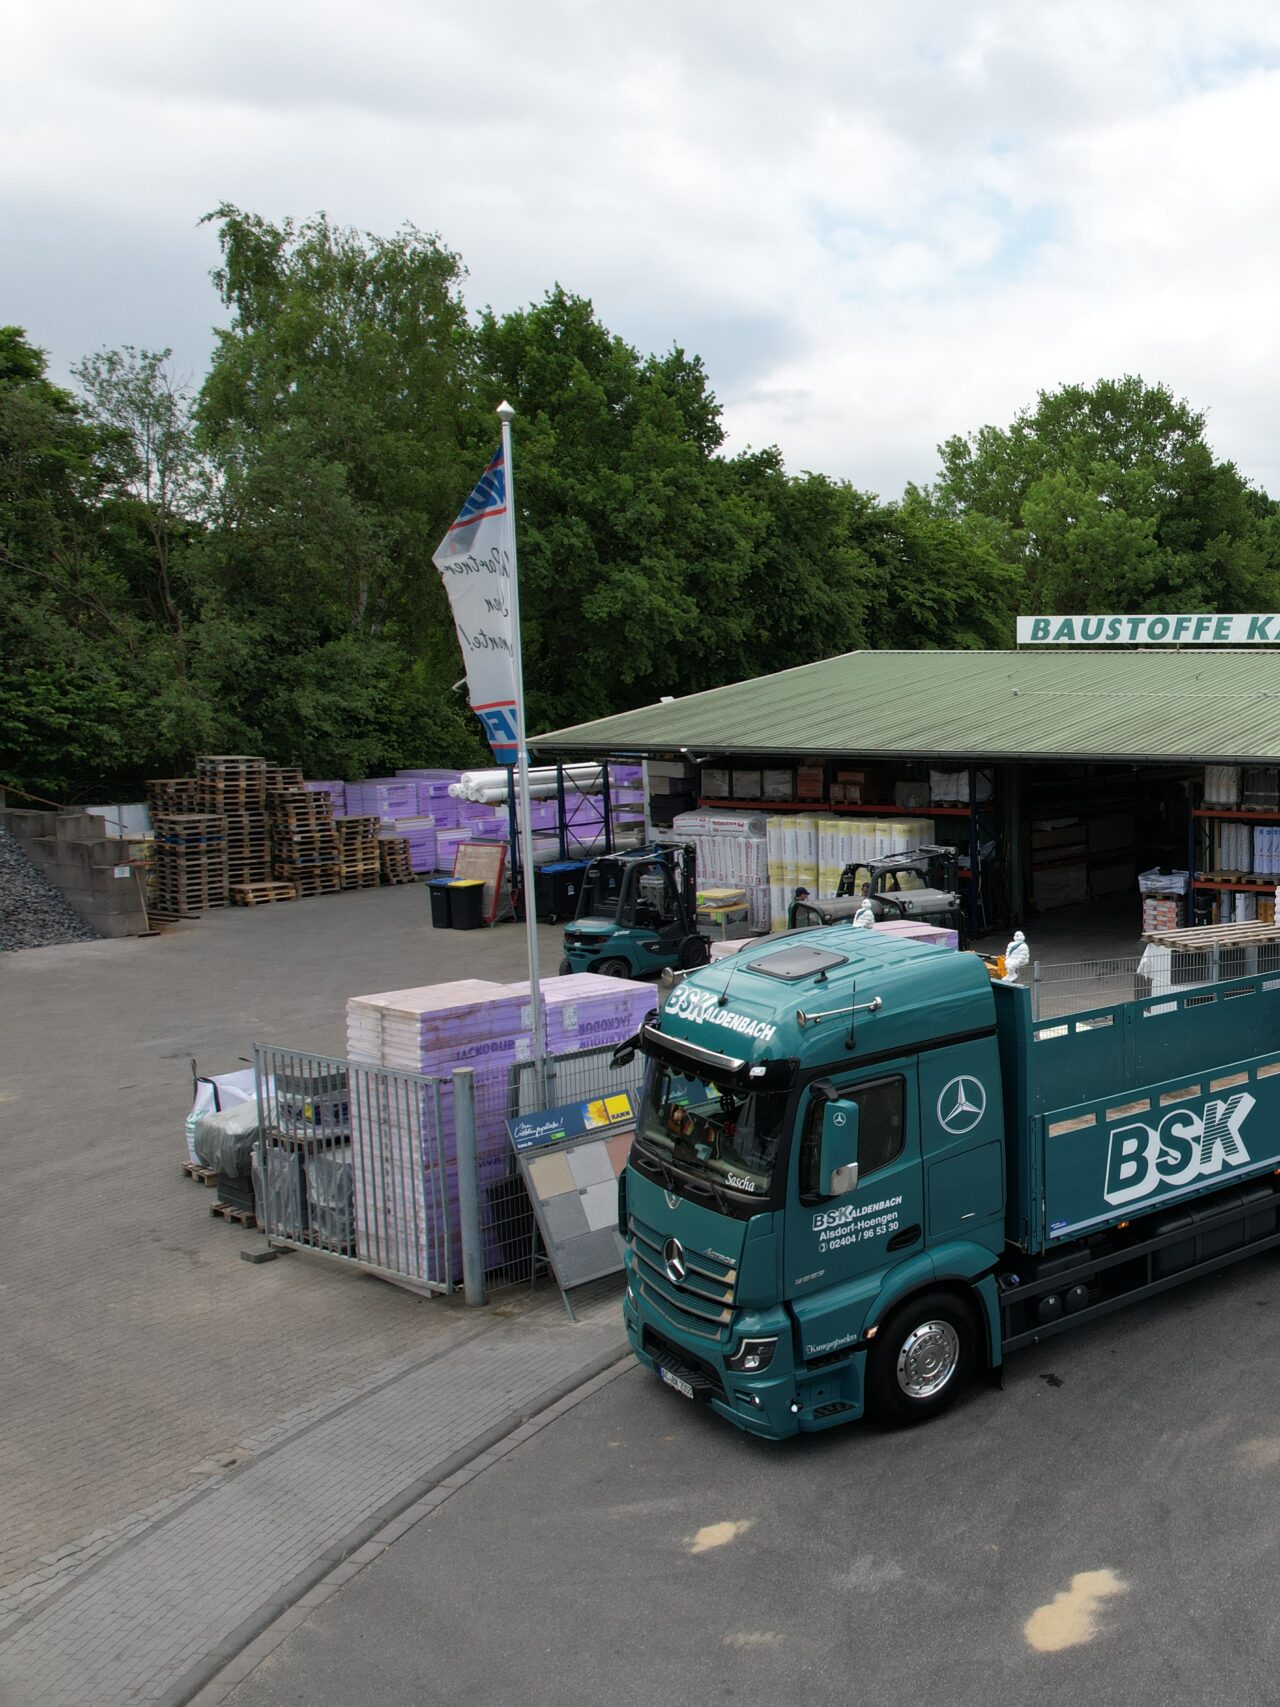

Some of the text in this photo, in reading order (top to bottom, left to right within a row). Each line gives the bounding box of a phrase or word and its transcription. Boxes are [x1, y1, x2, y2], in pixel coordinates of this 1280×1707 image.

[1030, 616, 1234, 641] BAUSTOFFE
[1103, 1091, 1257, 1206] BSK
[725, 1172, 756, 1192] Sascha
[819, 1211, 898, 1242] Alsdorf-Hoengen
[829, 1235, 857, 1250] 02404
[863, 1230, 875, 1240] 96
[876, 1225, 887, 1236] 53
[888, 1221, 899, 1232] 30
